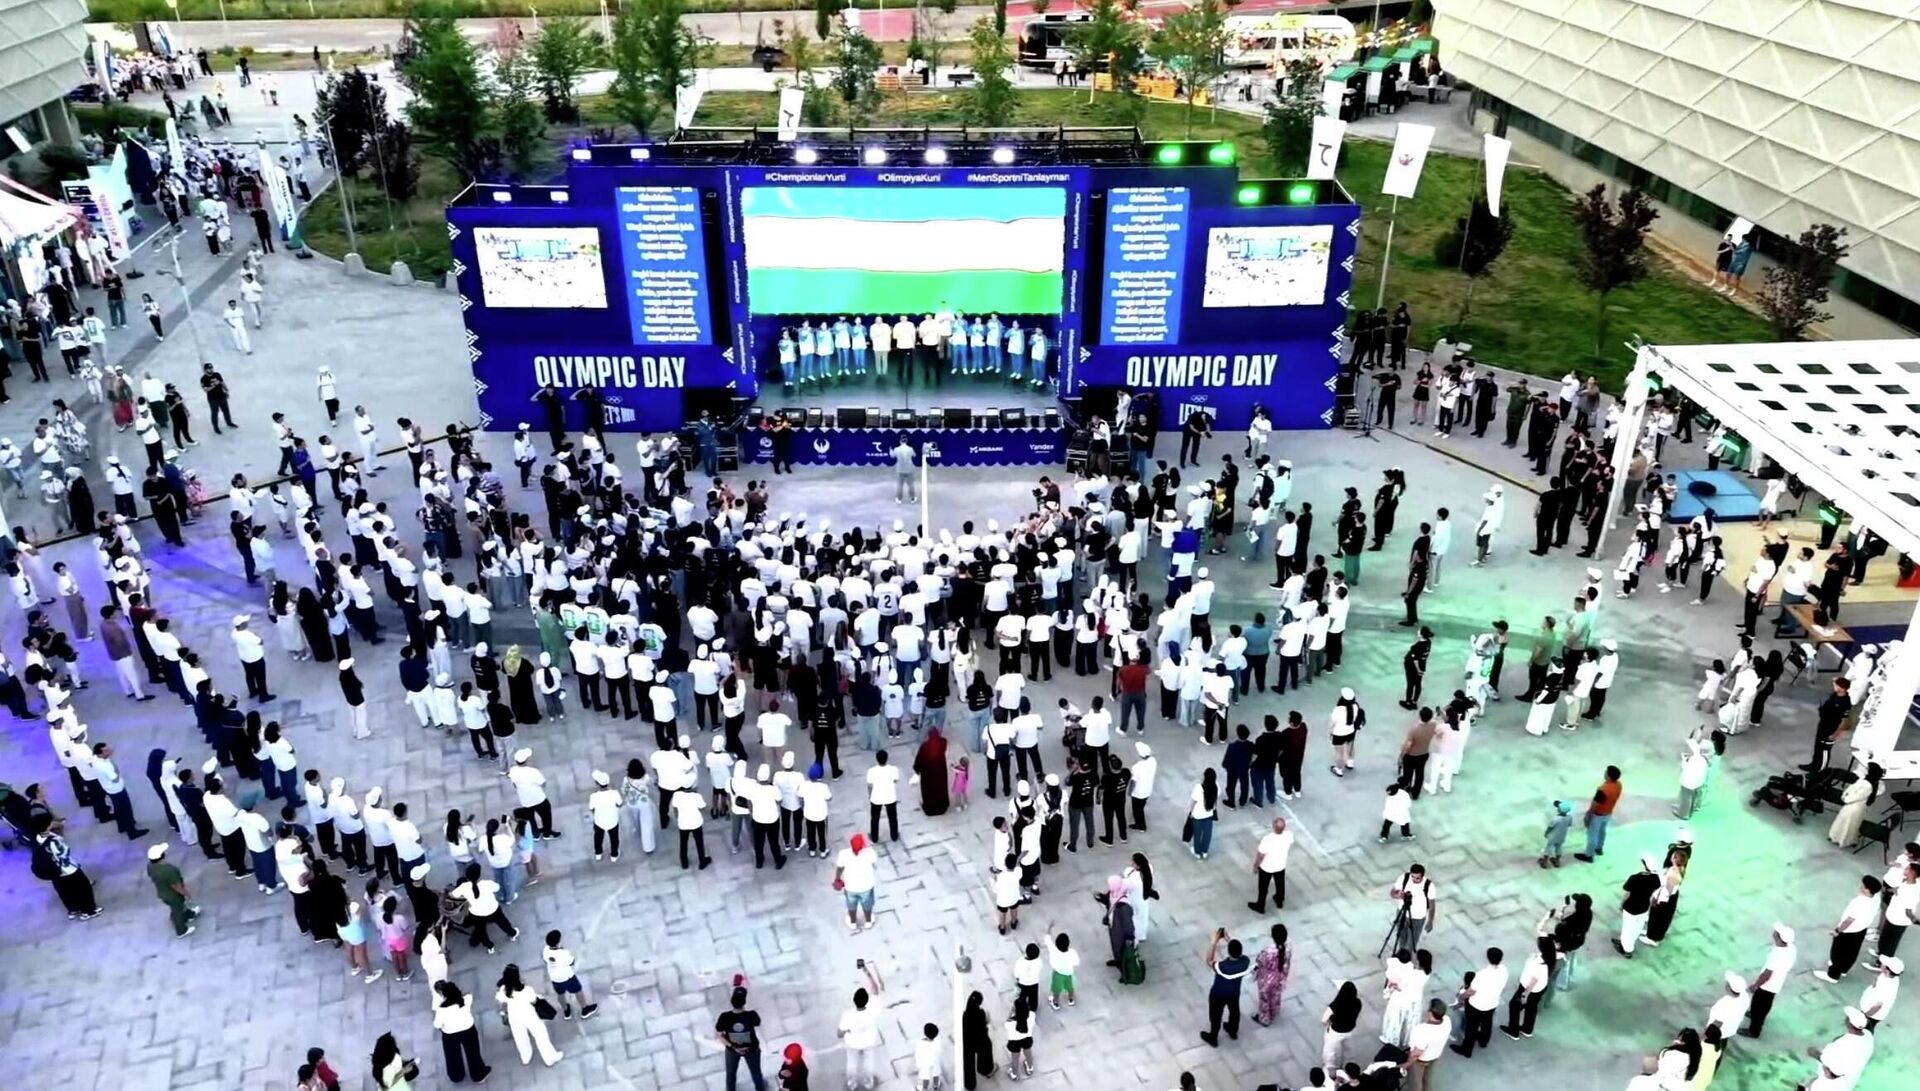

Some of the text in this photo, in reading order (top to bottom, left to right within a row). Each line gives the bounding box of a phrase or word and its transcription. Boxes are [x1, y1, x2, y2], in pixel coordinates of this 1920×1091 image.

[878, 173, 941, 184] #OlimpiyaKuni
[534, 356, 685, 388] OLYMPIC DAY
[1126, 354, 1278, 387] OLYMPIC DAY
[884, 594, 892, 608] 2
